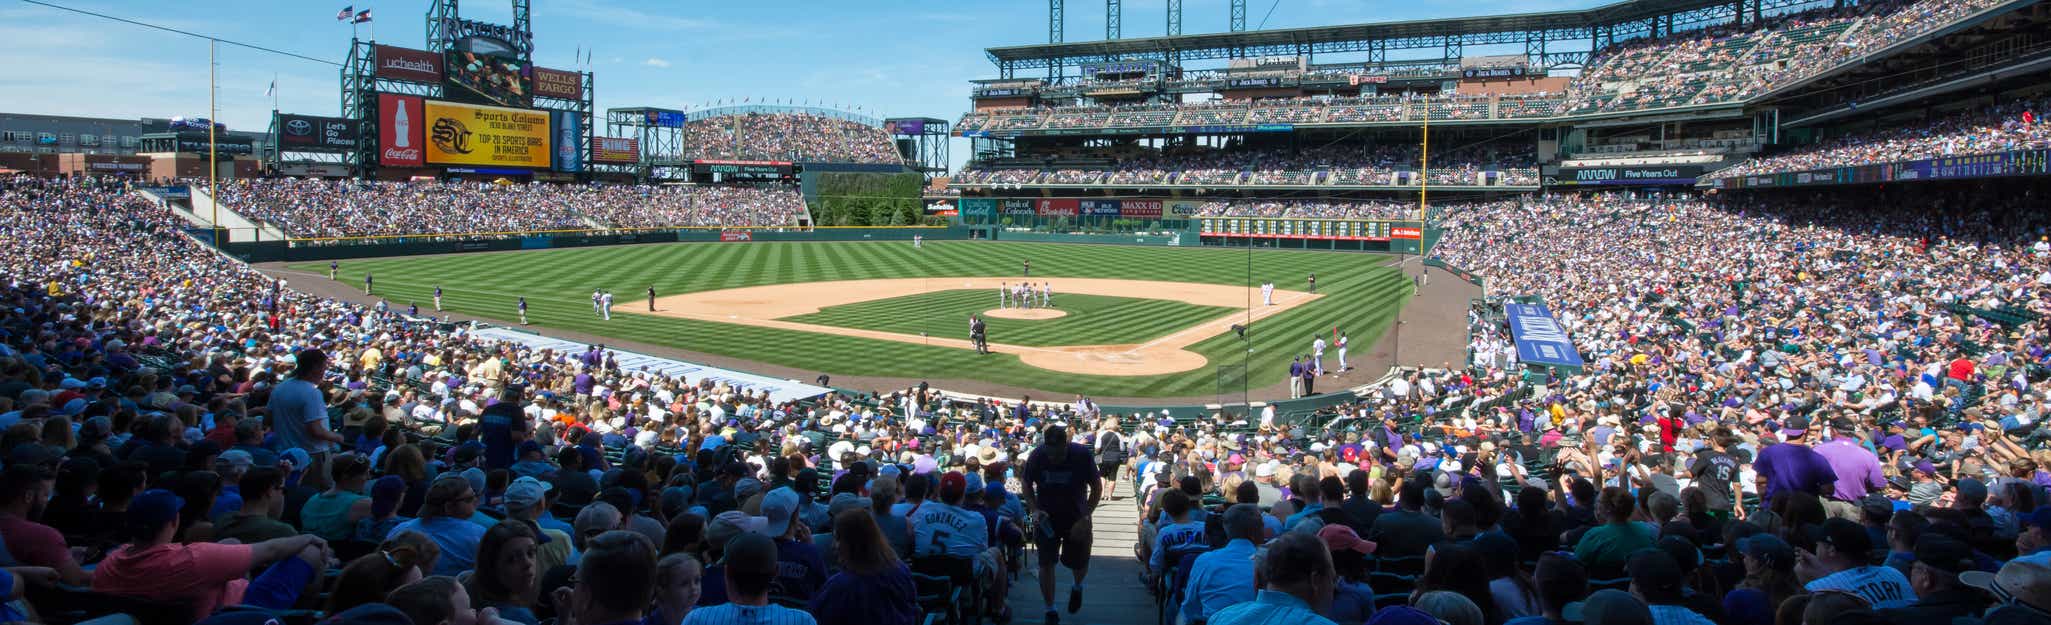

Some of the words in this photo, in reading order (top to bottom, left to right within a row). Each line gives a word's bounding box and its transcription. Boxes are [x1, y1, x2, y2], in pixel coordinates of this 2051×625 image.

[384, 56, 434, 72] uchealth
[538, 71, 576, 85] WELLS
[539, 82, 577, 94] FARGO
[475, 111, 508, 122] Sports
[511, 112, 545, 125] Column
[326, 121, 346, 130] Let's
[326, 129, 339, 137] Go
[479, 133, 491, 144] TOP
[492, 134, 501, 145] 20
[502, 135, 526, 146] SPORTS
[527, 137, 543, 147] BARS
[384, 147, 418, 160] Coca-Cola
[494, 145, 501, 153] IN
[502, 145, 529, 155] AMERICA
[1625, 170, 1640, 178] Five
[1641, 170, 1662, 178] Years
[1663, 169, 1677, 177] Out
[1122, 201, 1146, 209] MAXX
[1148, 201, 1161, 209] HD
[925, 511, 967, 530] GONZALEZ
[931, 529, 950, 554] 5
